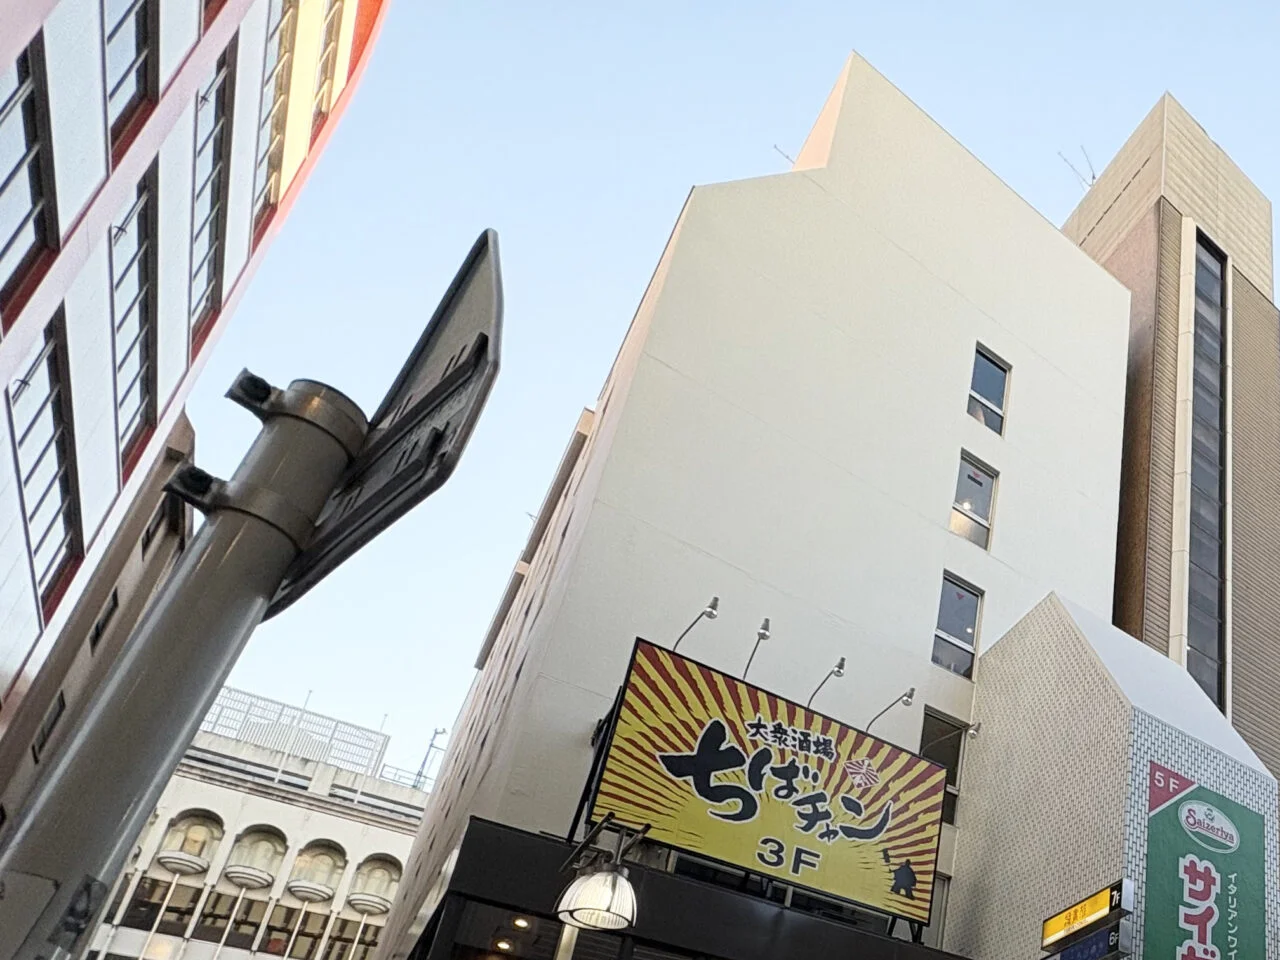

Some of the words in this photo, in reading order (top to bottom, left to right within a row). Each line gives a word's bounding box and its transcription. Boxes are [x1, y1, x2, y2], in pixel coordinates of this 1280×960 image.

[747, 717, 835, 761] 大衆酒場
[658, 719, 893, 844] ちばチャン
[1154, 771, 1180, 793] 5F
[1184, 807, 1235, 844] Saizeriya
[756, 837, 822, 877] 3F
[1111, 891, 1121, 907] 7F
